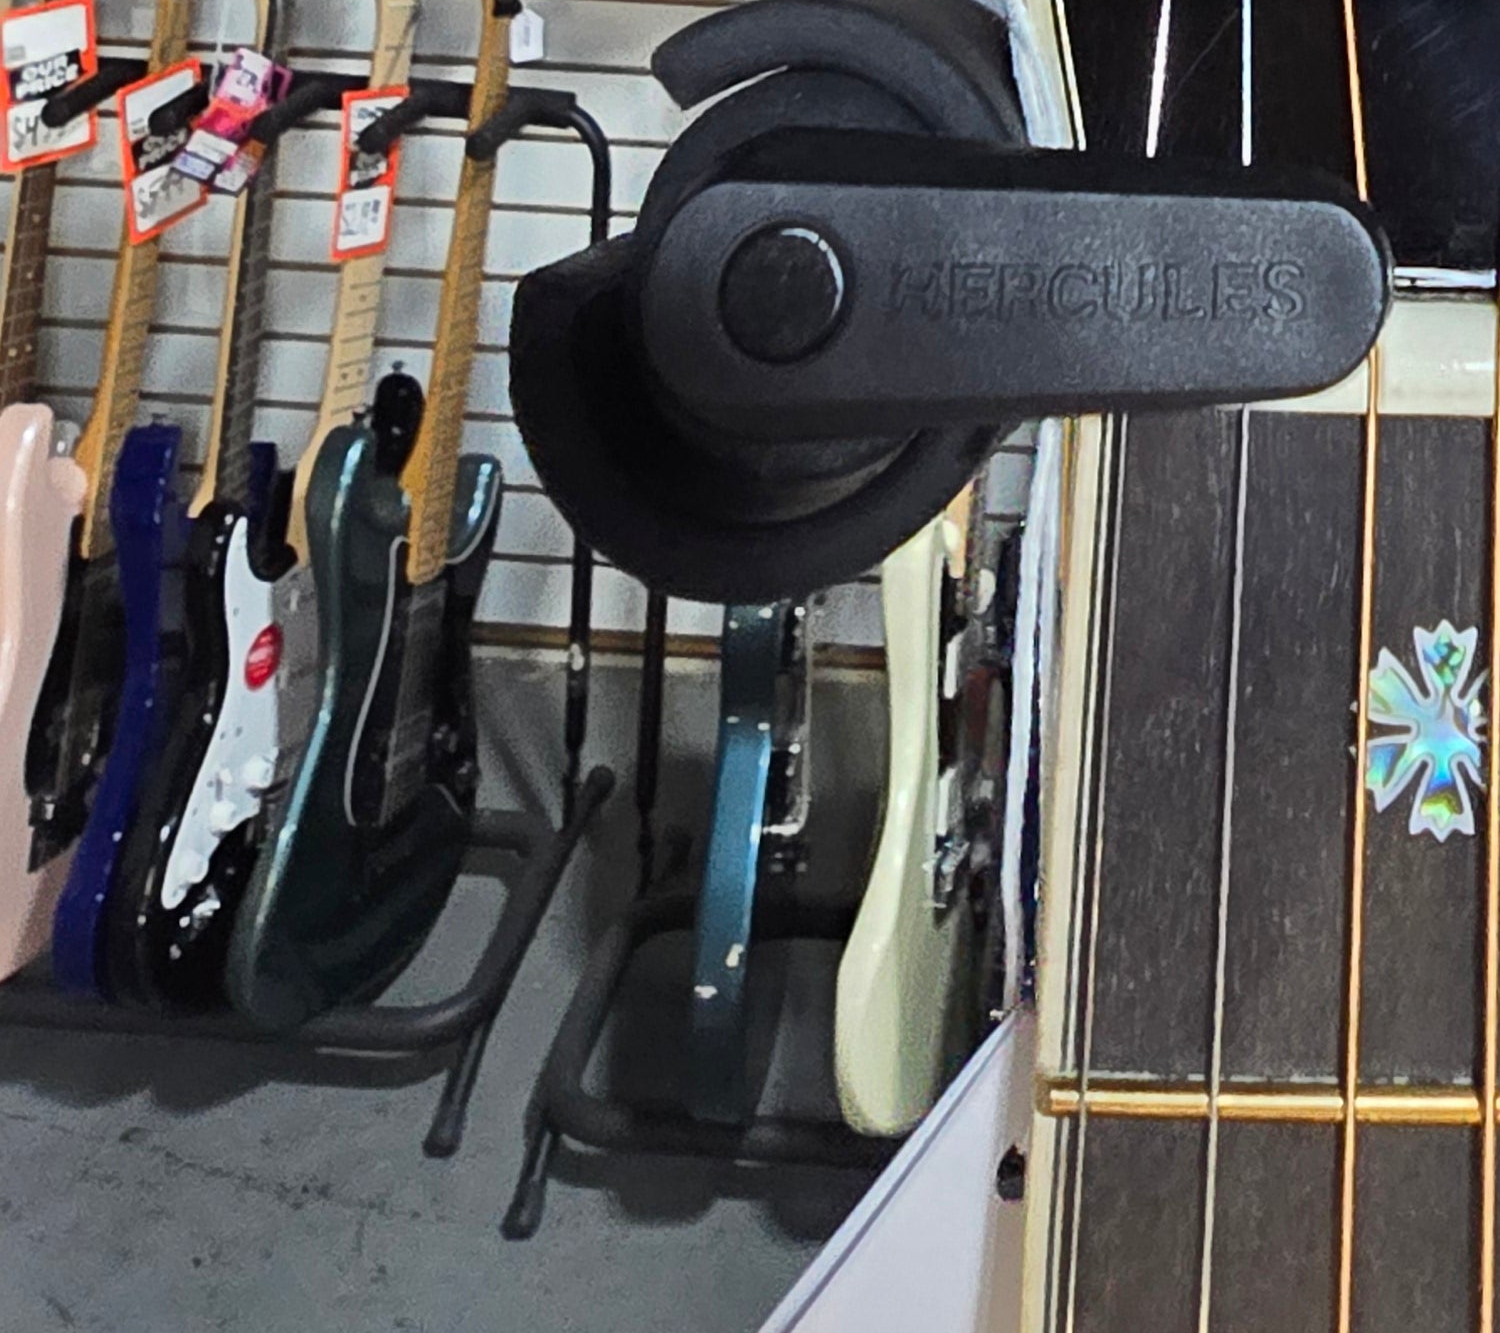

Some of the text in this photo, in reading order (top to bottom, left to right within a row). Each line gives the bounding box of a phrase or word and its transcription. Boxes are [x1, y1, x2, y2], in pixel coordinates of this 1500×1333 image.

[15, 63, 79, 100] PRICE
[21, 53, 69, 82] OUR
[892, 259, 1306, 320] HERCULES
